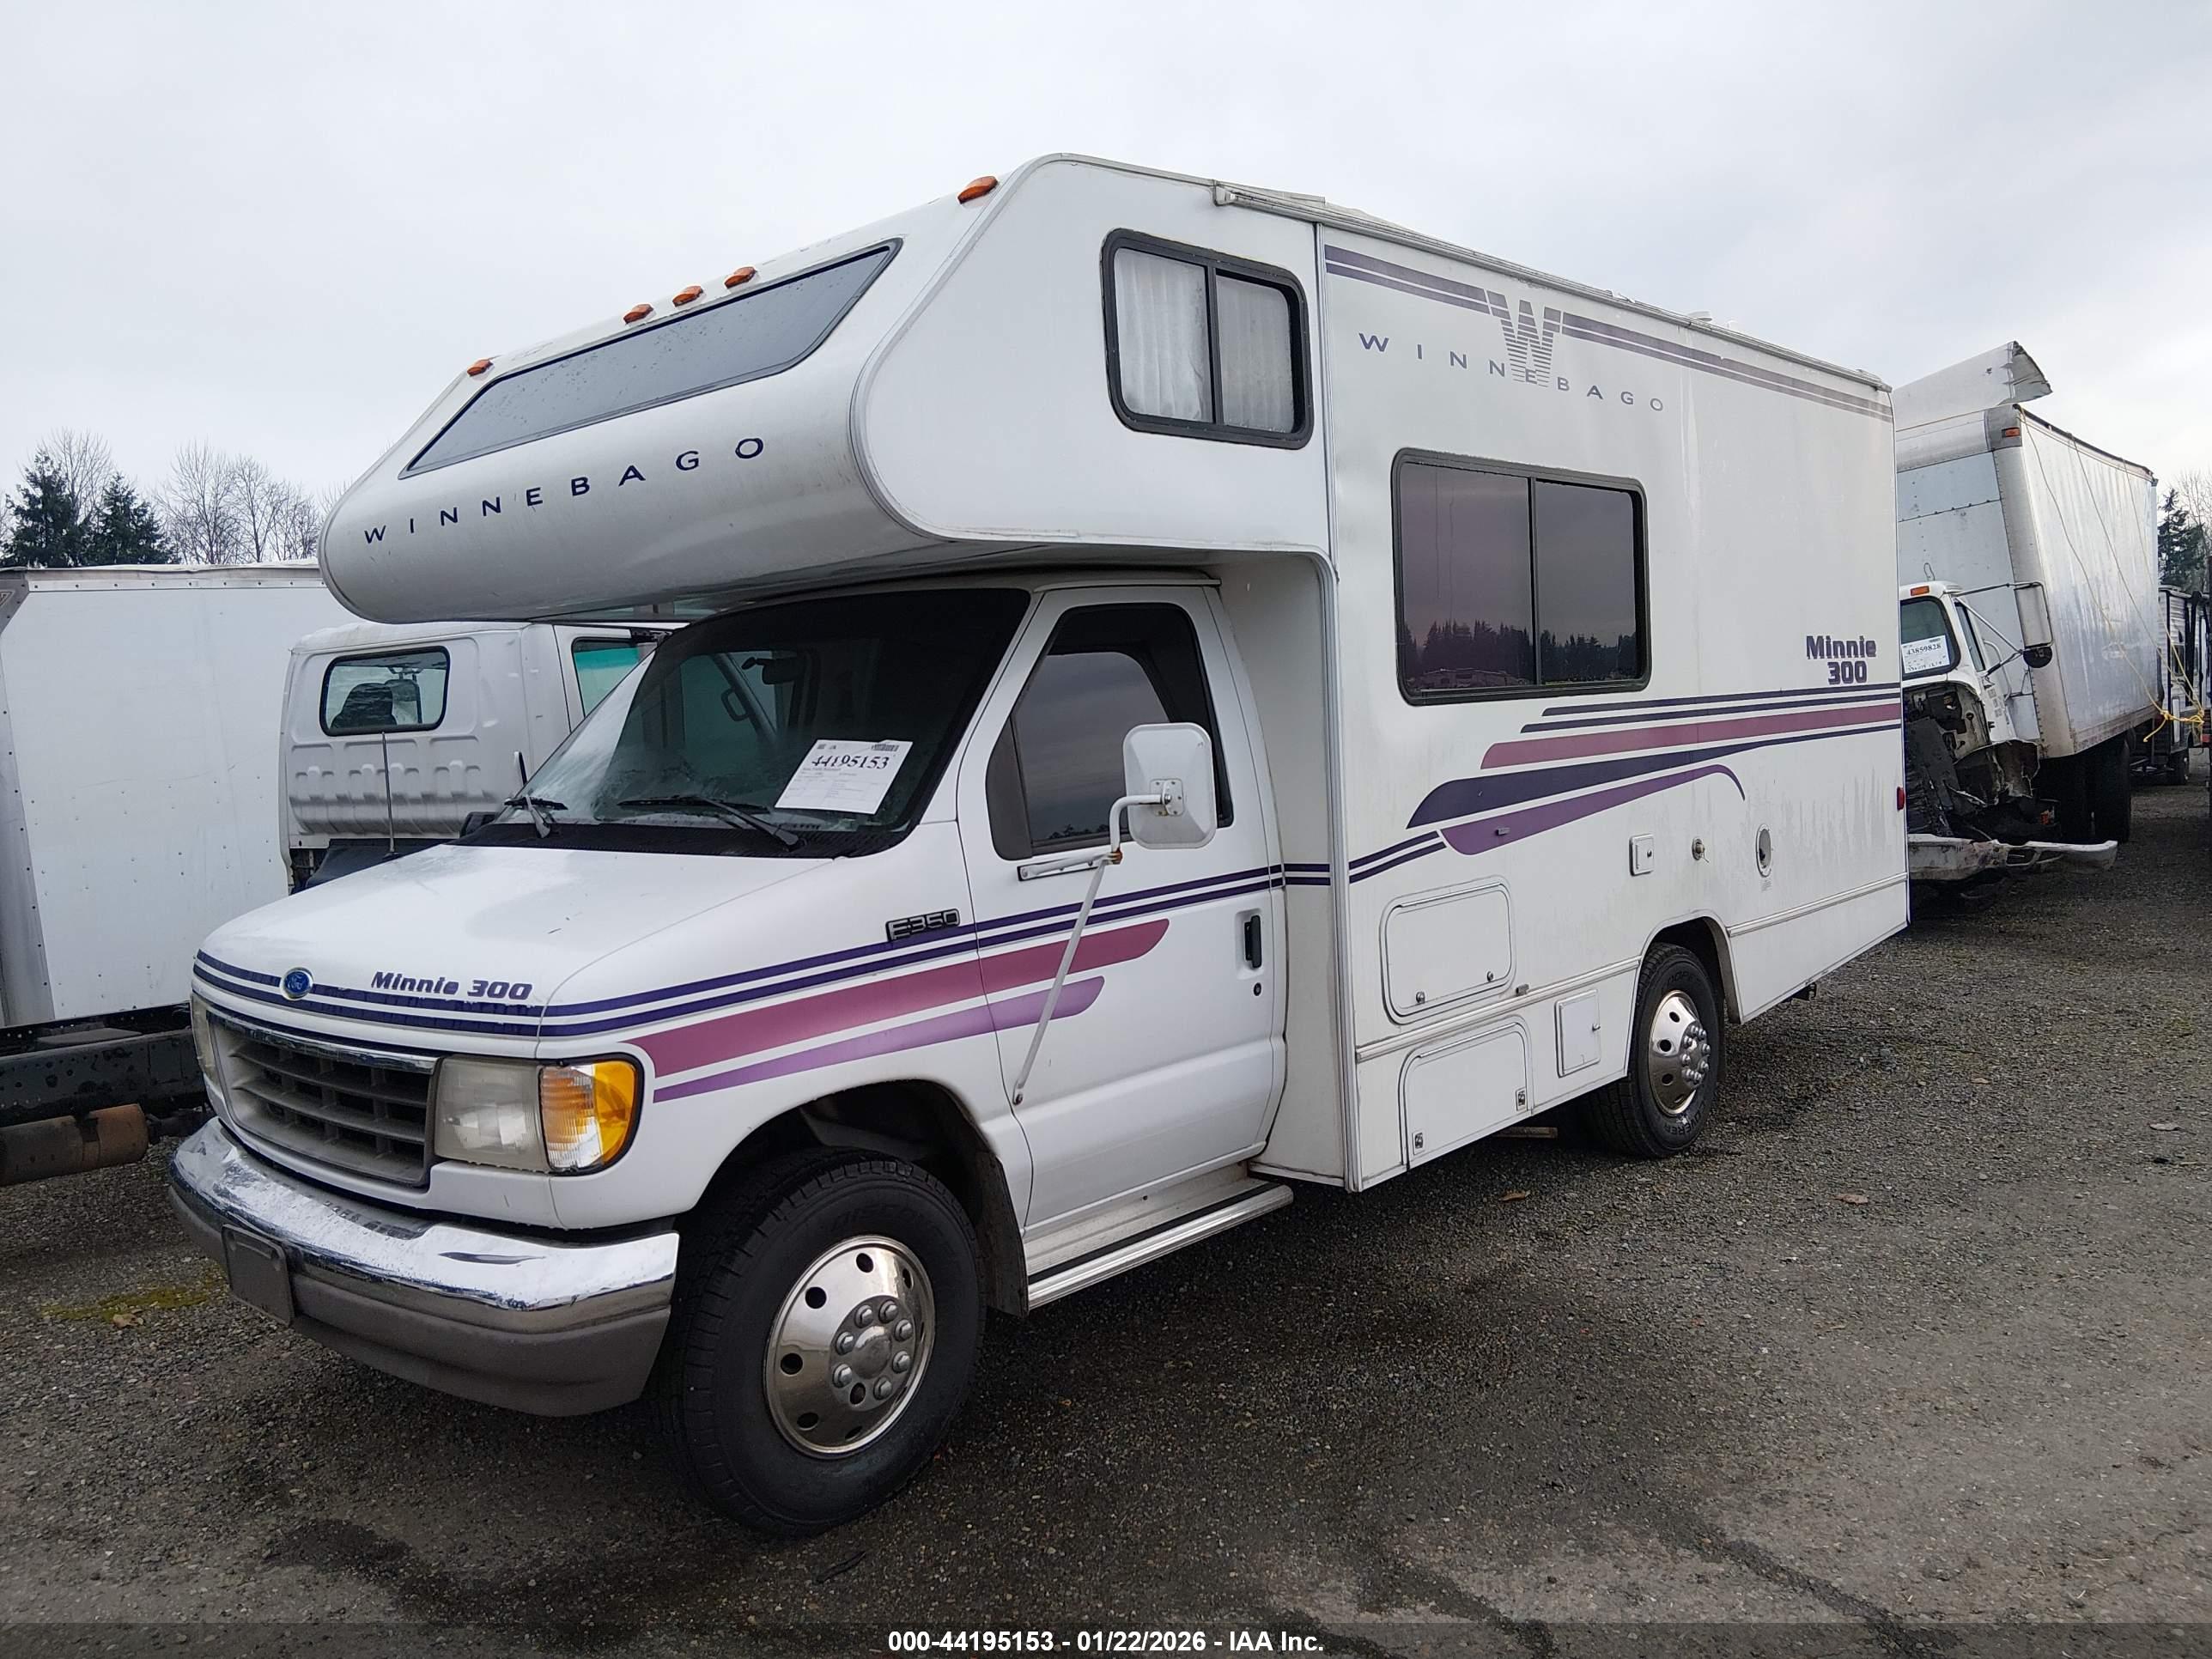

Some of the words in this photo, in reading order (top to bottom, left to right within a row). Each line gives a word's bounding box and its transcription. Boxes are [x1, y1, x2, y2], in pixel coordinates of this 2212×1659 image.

[1358, 332, 1664, 411] WINNEBAGO
[364, 437, 764, 544] WINNEBAGO
[1806, 635, 1876, 659] Minnie
[1826, 661, 1867, 684] 300
[811, 755, 890, 769] 44195153
[371, 971, 459, 995] Minnie
[467, 980, 533, 1000] 300
